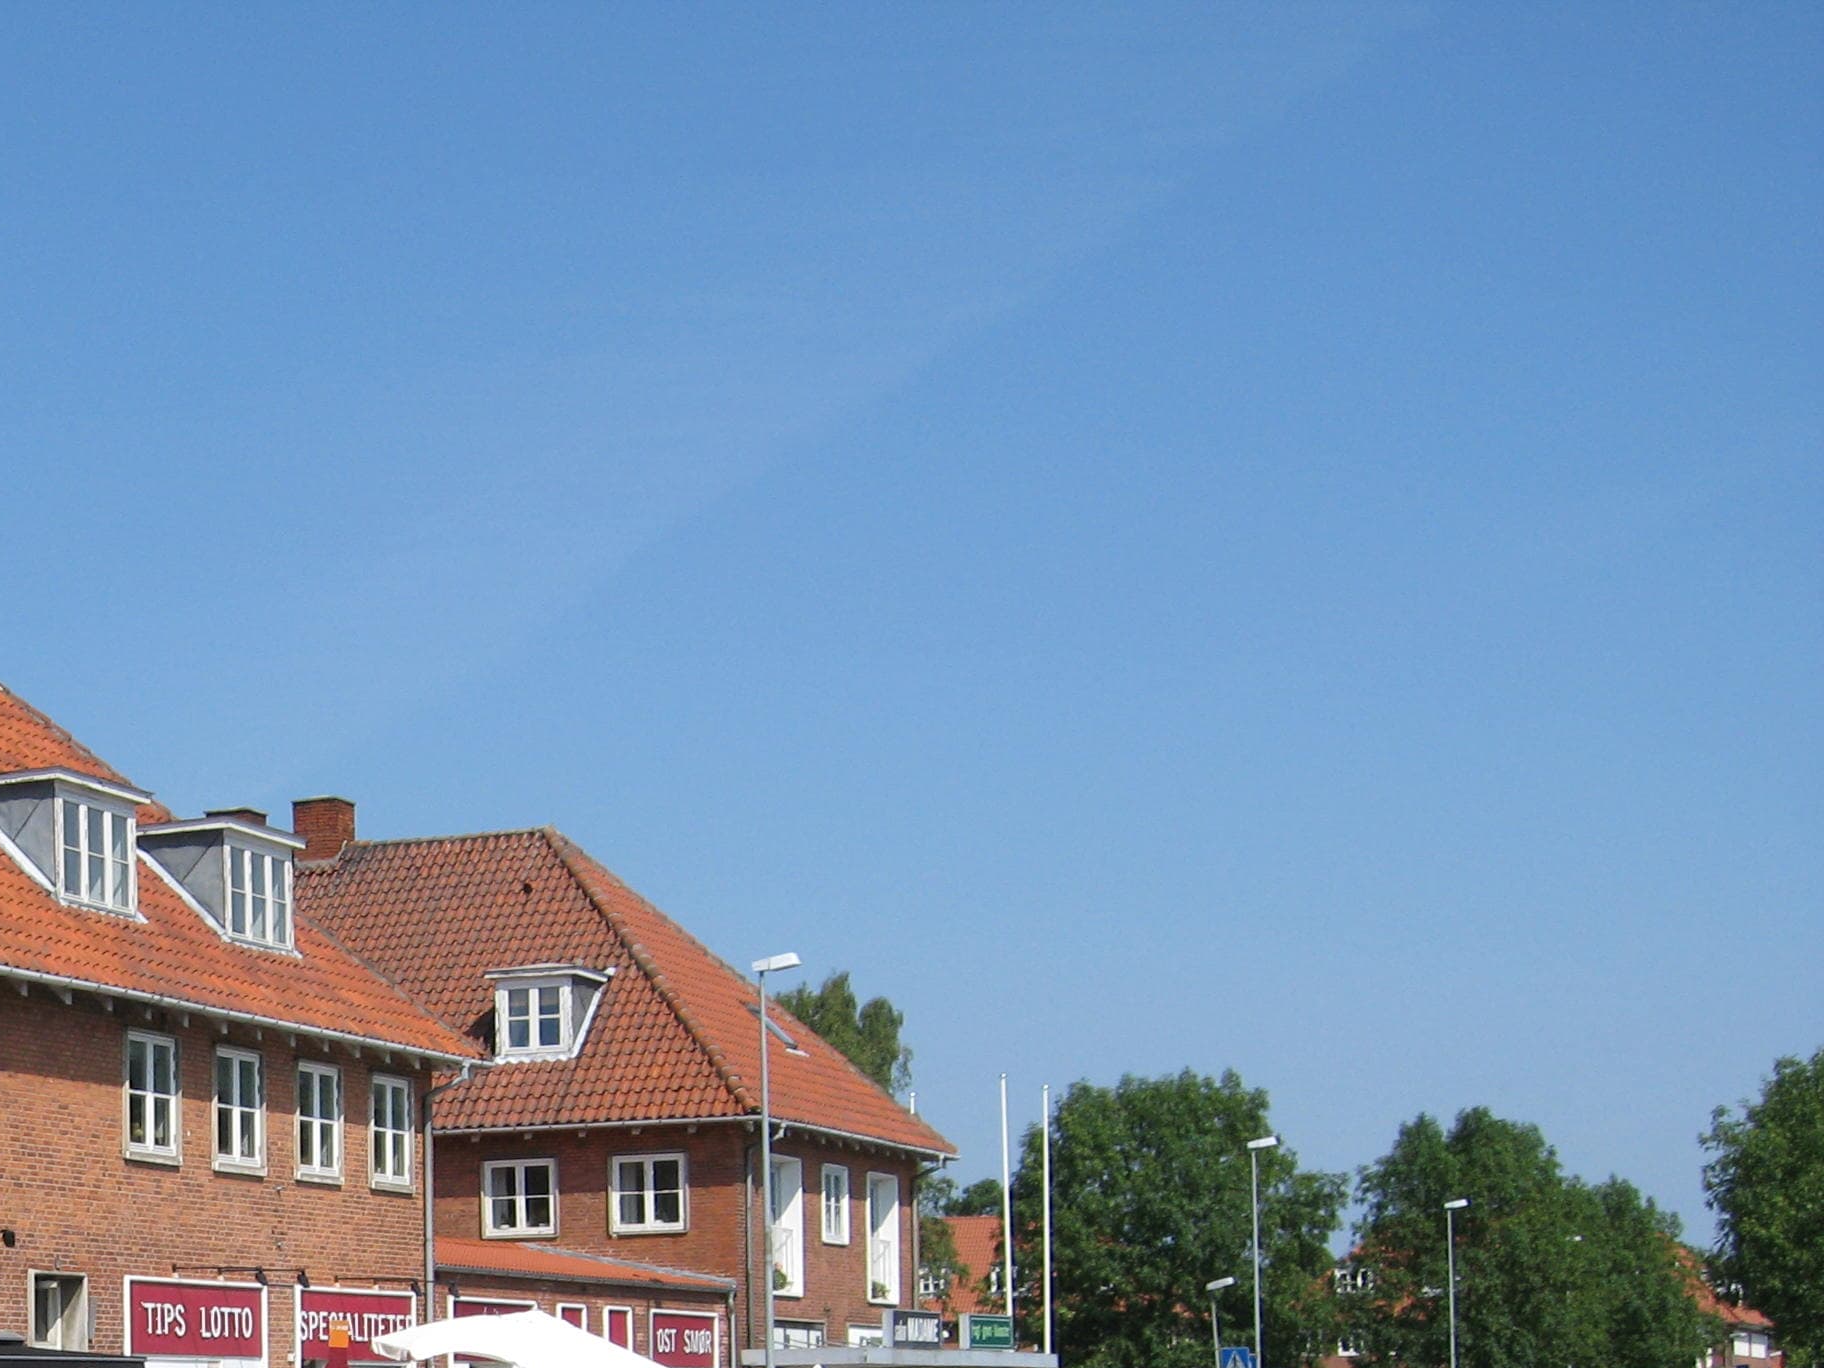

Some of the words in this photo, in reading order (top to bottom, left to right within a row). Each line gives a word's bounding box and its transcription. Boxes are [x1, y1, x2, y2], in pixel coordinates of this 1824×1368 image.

[141, 1301, 186, 1336] TIPS
[199, 1306, 253, 1339] LOTTO
[656, 1328, 677, 1353] OST
[683, 1328, 712, 1355] SMØR
